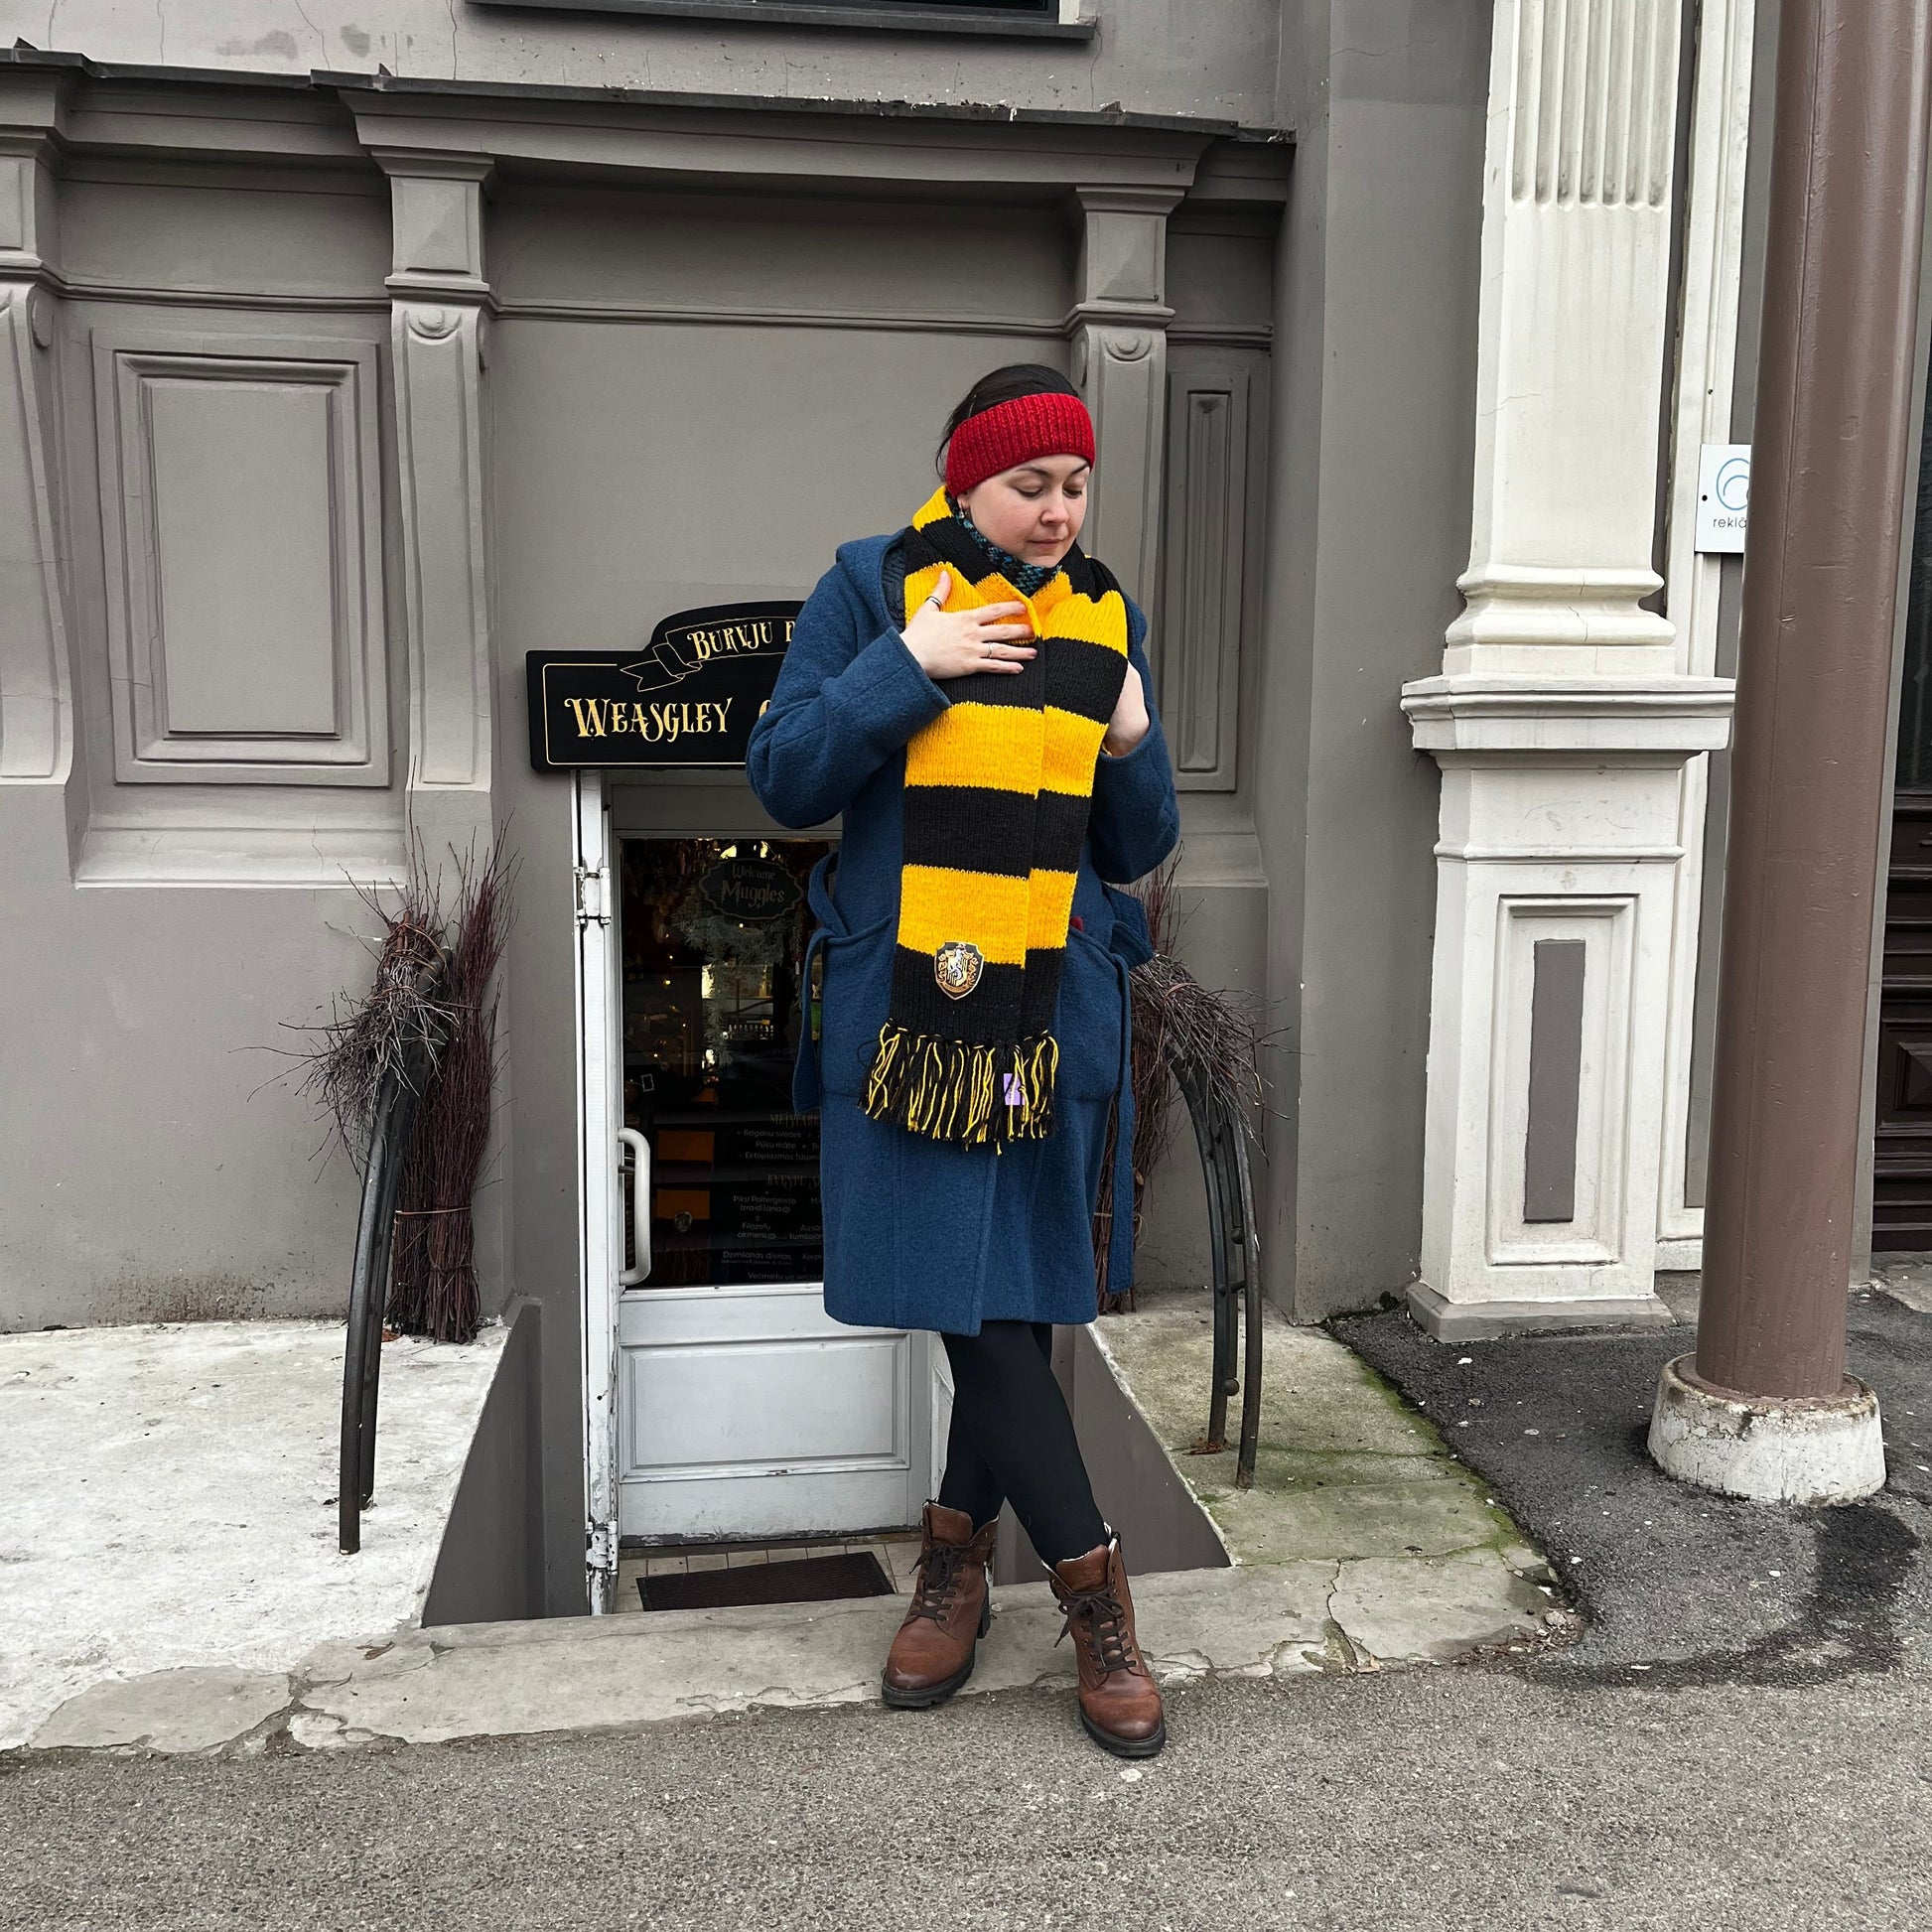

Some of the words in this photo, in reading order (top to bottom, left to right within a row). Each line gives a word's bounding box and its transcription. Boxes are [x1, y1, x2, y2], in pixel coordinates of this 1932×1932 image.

[687, 621, 773, 660] BURVJU
[564, 697, 733, 742] WEASGLEY
[732, 863, 776, 881] Welcome
[721, 880, 785, 908] Muggles
